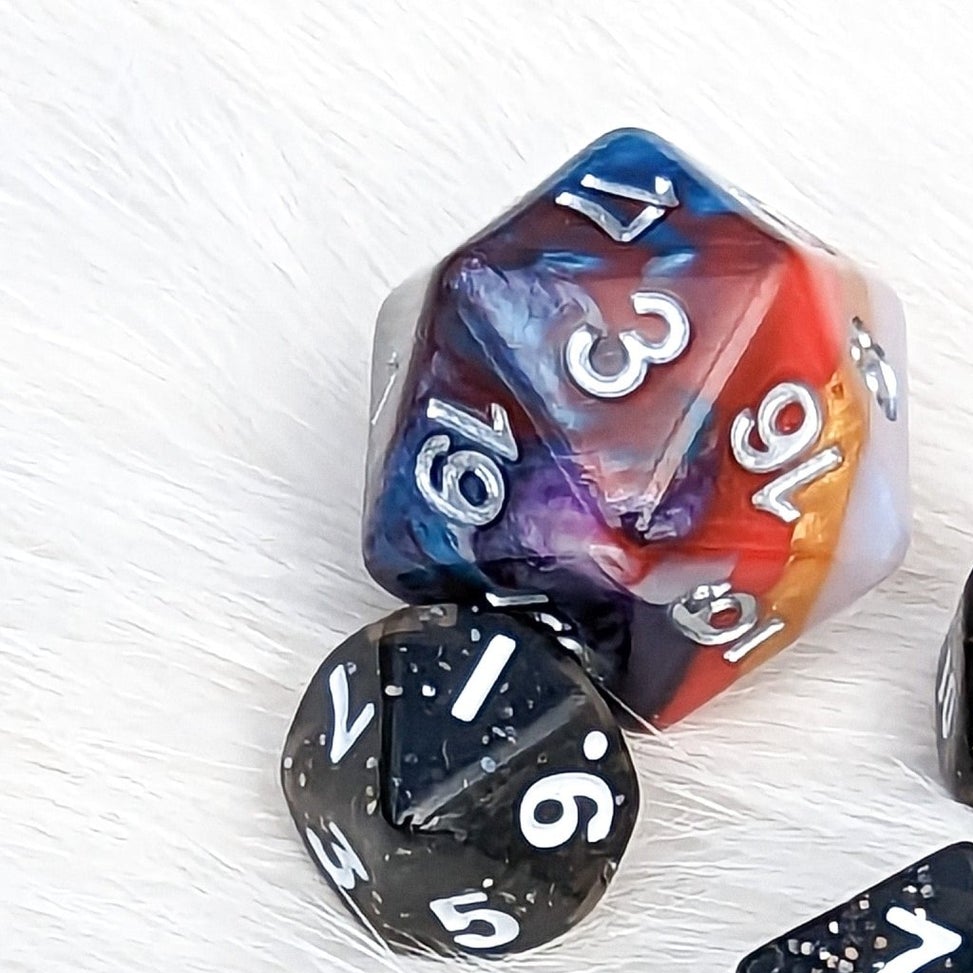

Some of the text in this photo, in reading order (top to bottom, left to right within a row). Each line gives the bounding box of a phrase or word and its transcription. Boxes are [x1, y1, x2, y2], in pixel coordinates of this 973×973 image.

[555, 173, 678, 242] 17
[565, 292, 690, 398] 3
[415, 398, 518, 526] 19
[731, 382, 843, 522] 16
[329, 664, 375, 764] 7
[452, 634, 516, 722] 1
[430, 892, 520, 949] 5
